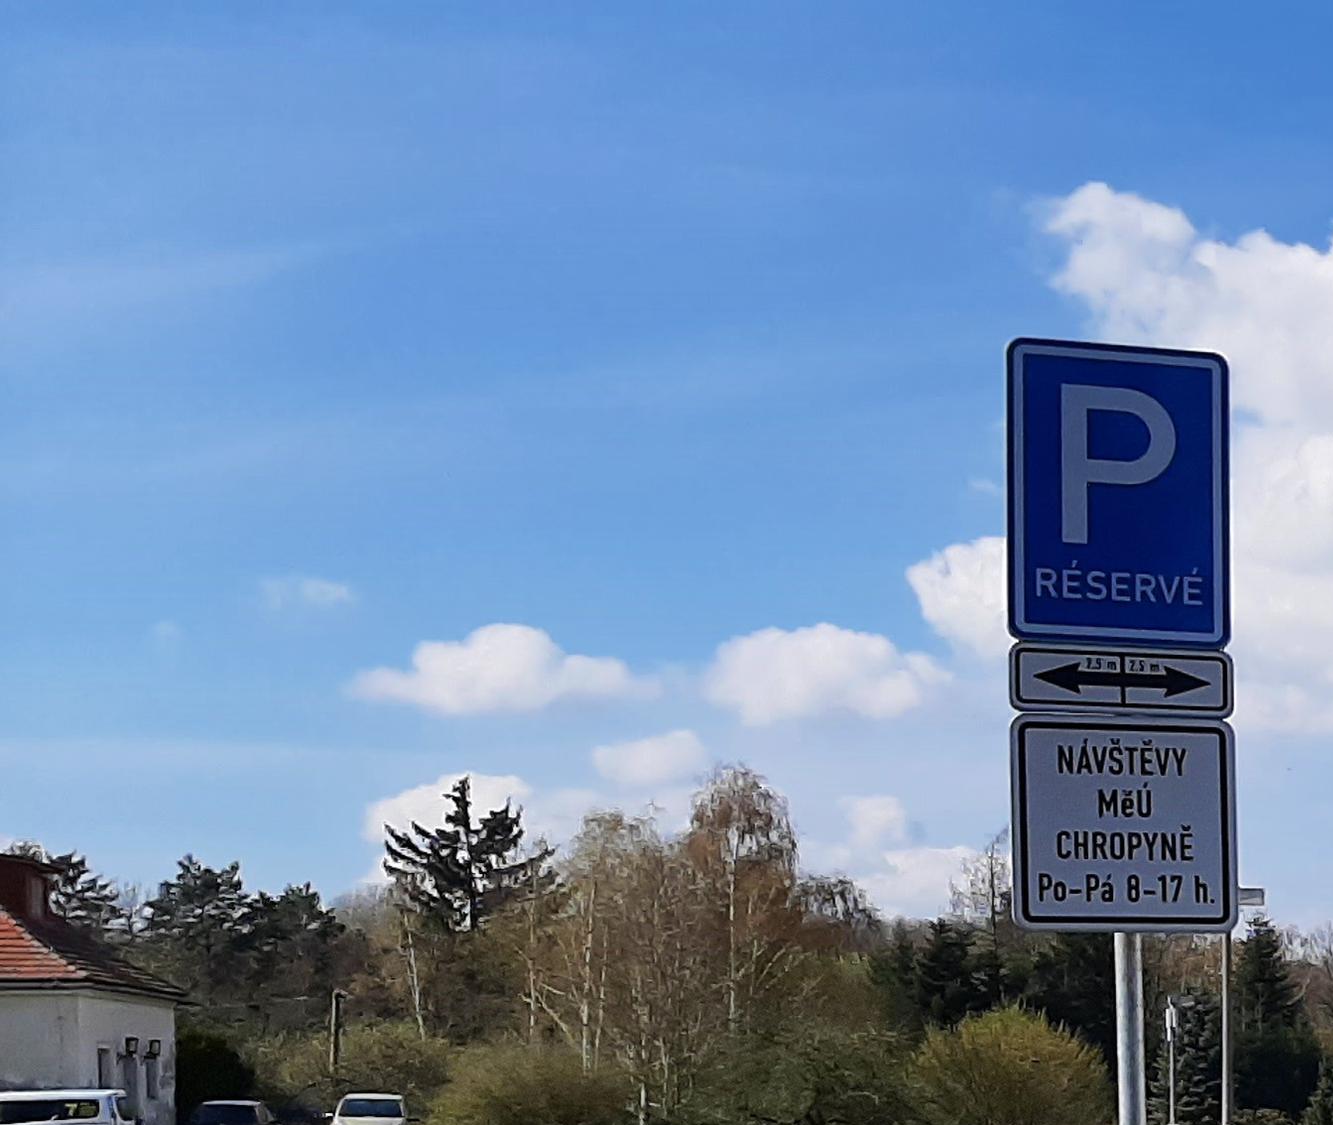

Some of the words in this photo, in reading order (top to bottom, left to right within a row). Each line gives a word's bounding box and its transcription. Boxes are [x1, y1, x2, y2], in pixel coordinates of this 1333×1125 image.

[1060, 382, 1177, 544] P
[1034, 559, 1204, 606] RÉSERVÉ
[1056, 737, 1188, 777] NÁVŠTĚVY
[1096, 781, 1153, 819] MěÚ
[1055, 823, 1195, 862] CHROPYNĚ
[1037, 872, 1115, 904] Po-Pá
[1126, 874, 1184, 904] 8-17
[1193, 875, 1216, 905] h.
